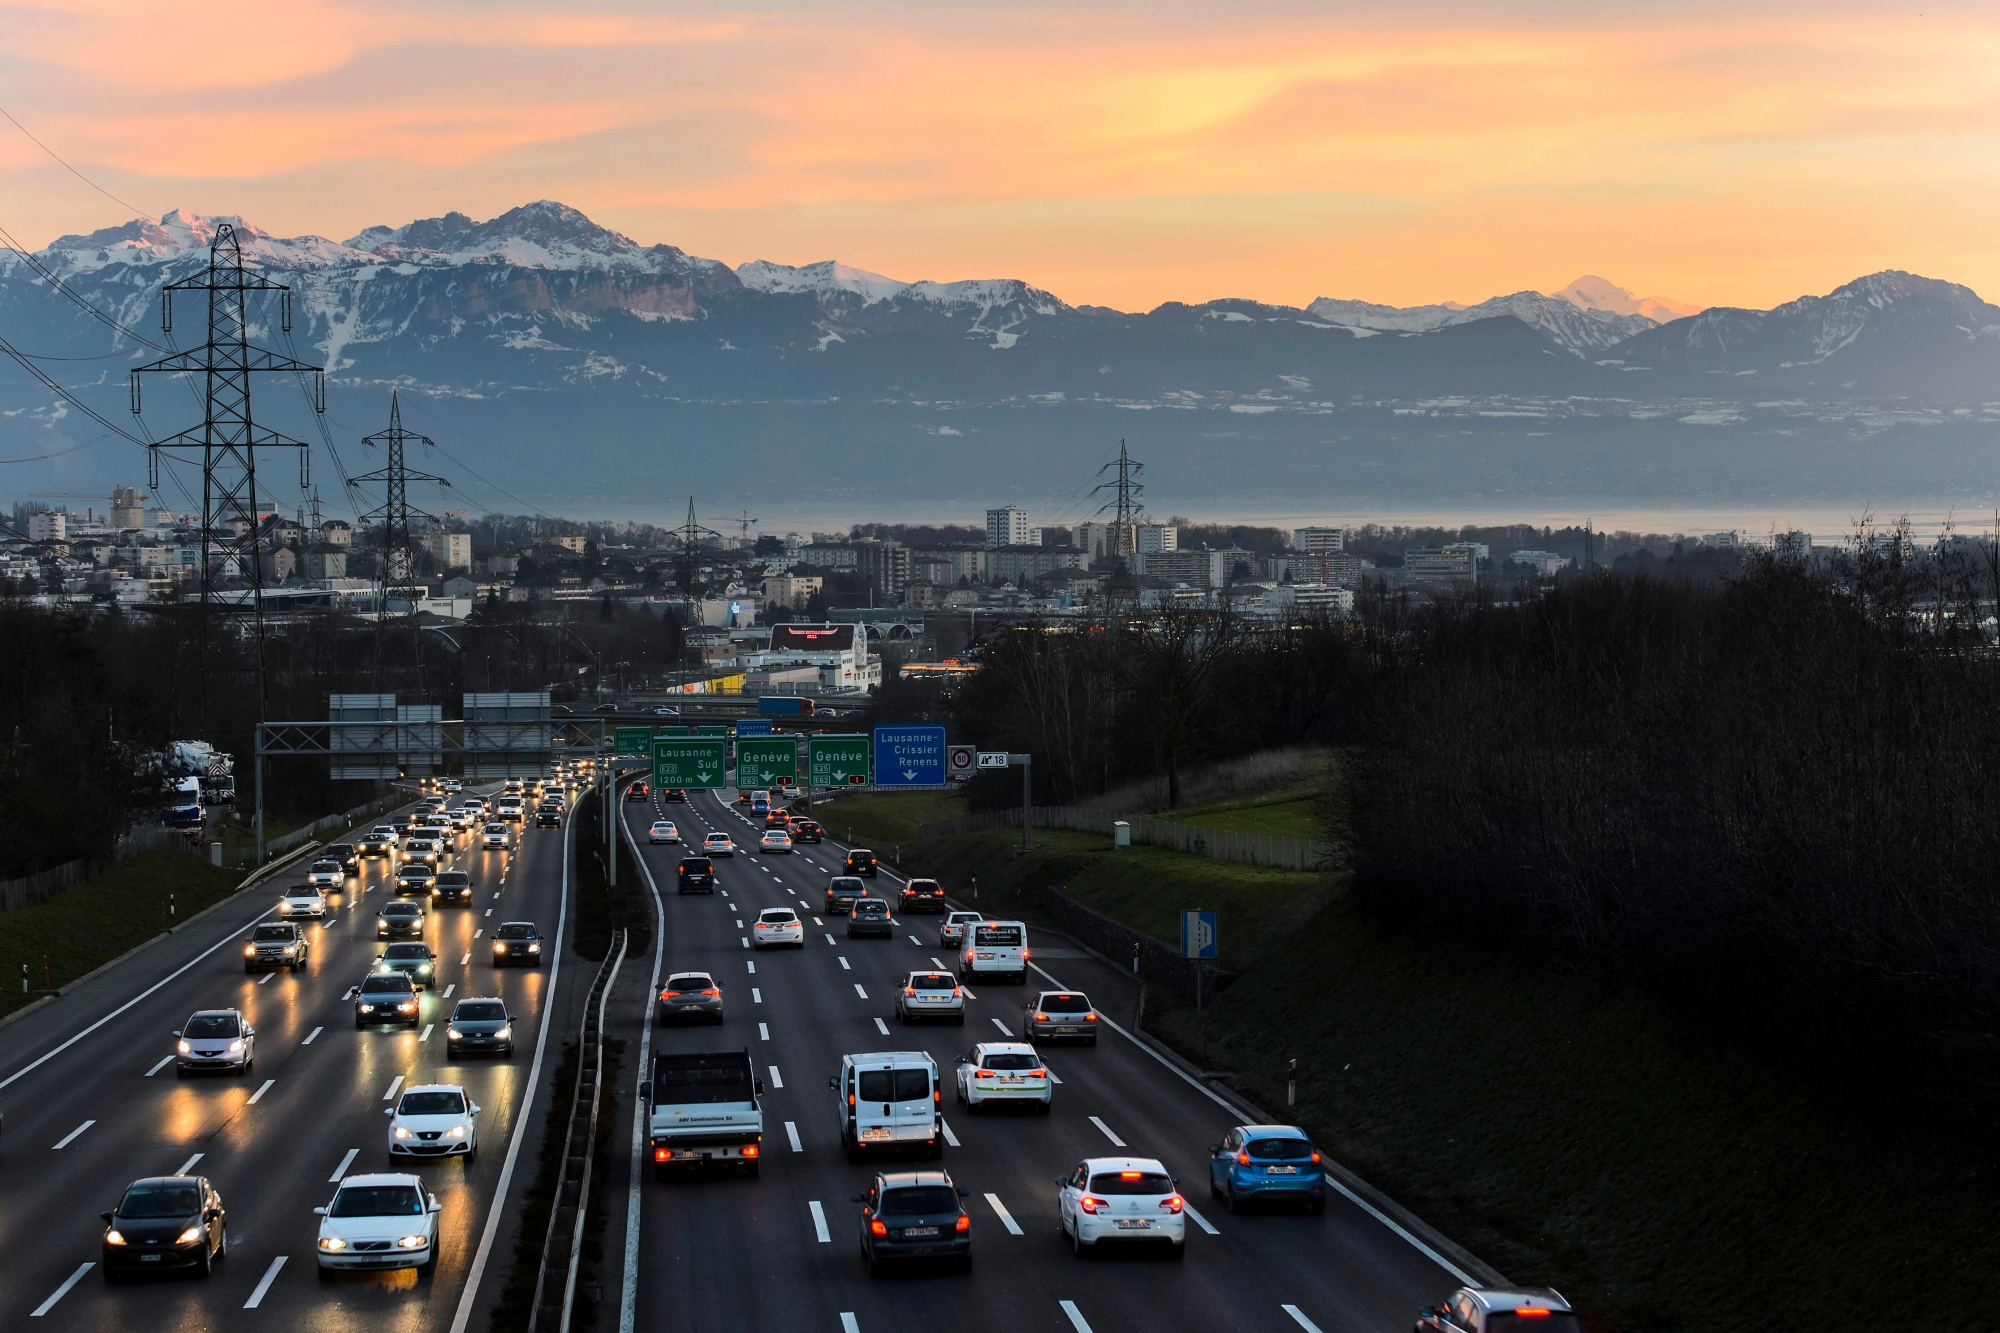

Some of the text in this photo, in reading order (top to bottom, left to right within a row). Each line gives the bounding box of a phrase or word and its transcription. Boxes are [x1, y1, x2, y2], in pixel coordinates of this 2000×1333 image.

[881, 733, 938, 743] Lausanne-
[660, 748, 718, 757] Lausanne-
[894, 745, 938, 754] Crissier
[743, 751, 790, 762] Genève
[816, 750, 862, 762] Genève
[957, 755, 966, 763] 80
[994, 755, 1004, 765] 18
[697, 759, 718, 769] Sud
[899, 757, 938, 766] Renens
[660, 776, 682, 784] 1200
